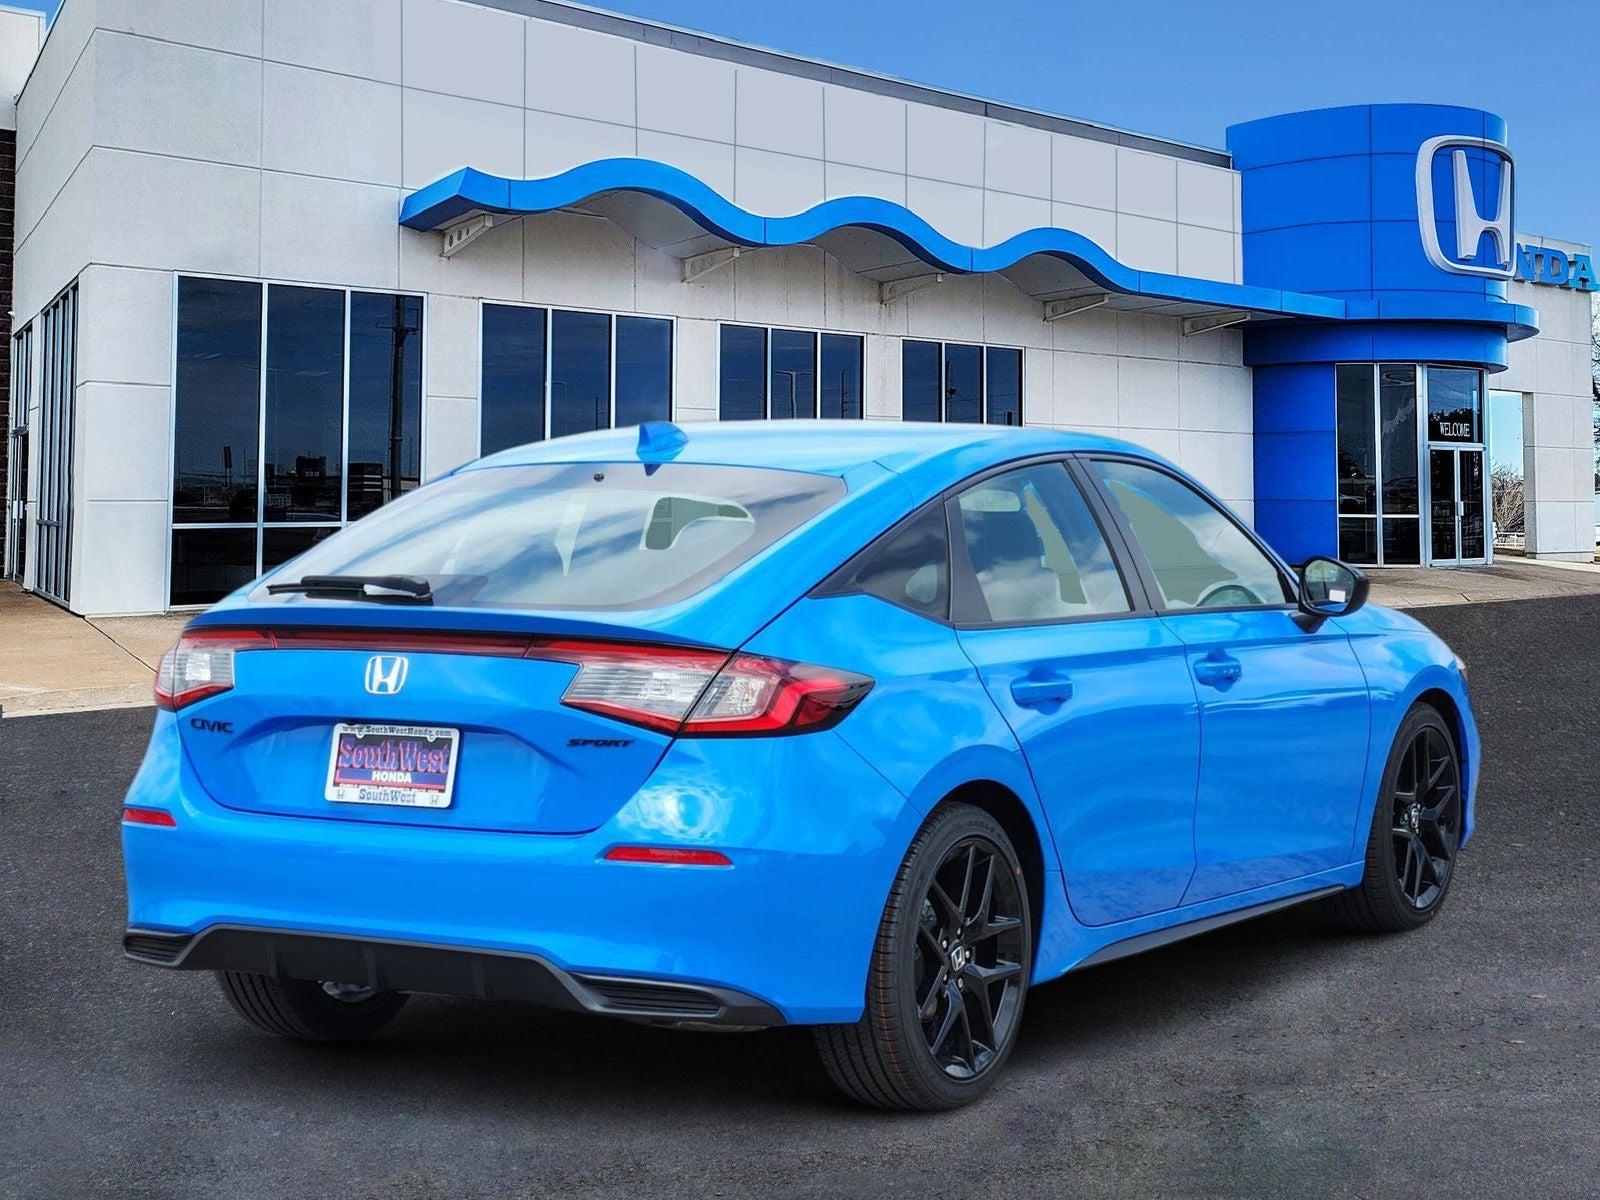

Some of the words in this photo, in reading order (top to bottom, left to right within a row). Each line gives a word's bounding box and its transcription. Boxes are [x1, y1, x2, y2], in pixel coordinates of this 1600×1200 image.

[1512, 243, 1600, 292] NDA
[1440, 422, 1470, 437] WELCOME
[190, 718, 234, 734] CIVIC
[566, 738, 636, 748] SPORT
[371, 771, 412, 783] HONDA
